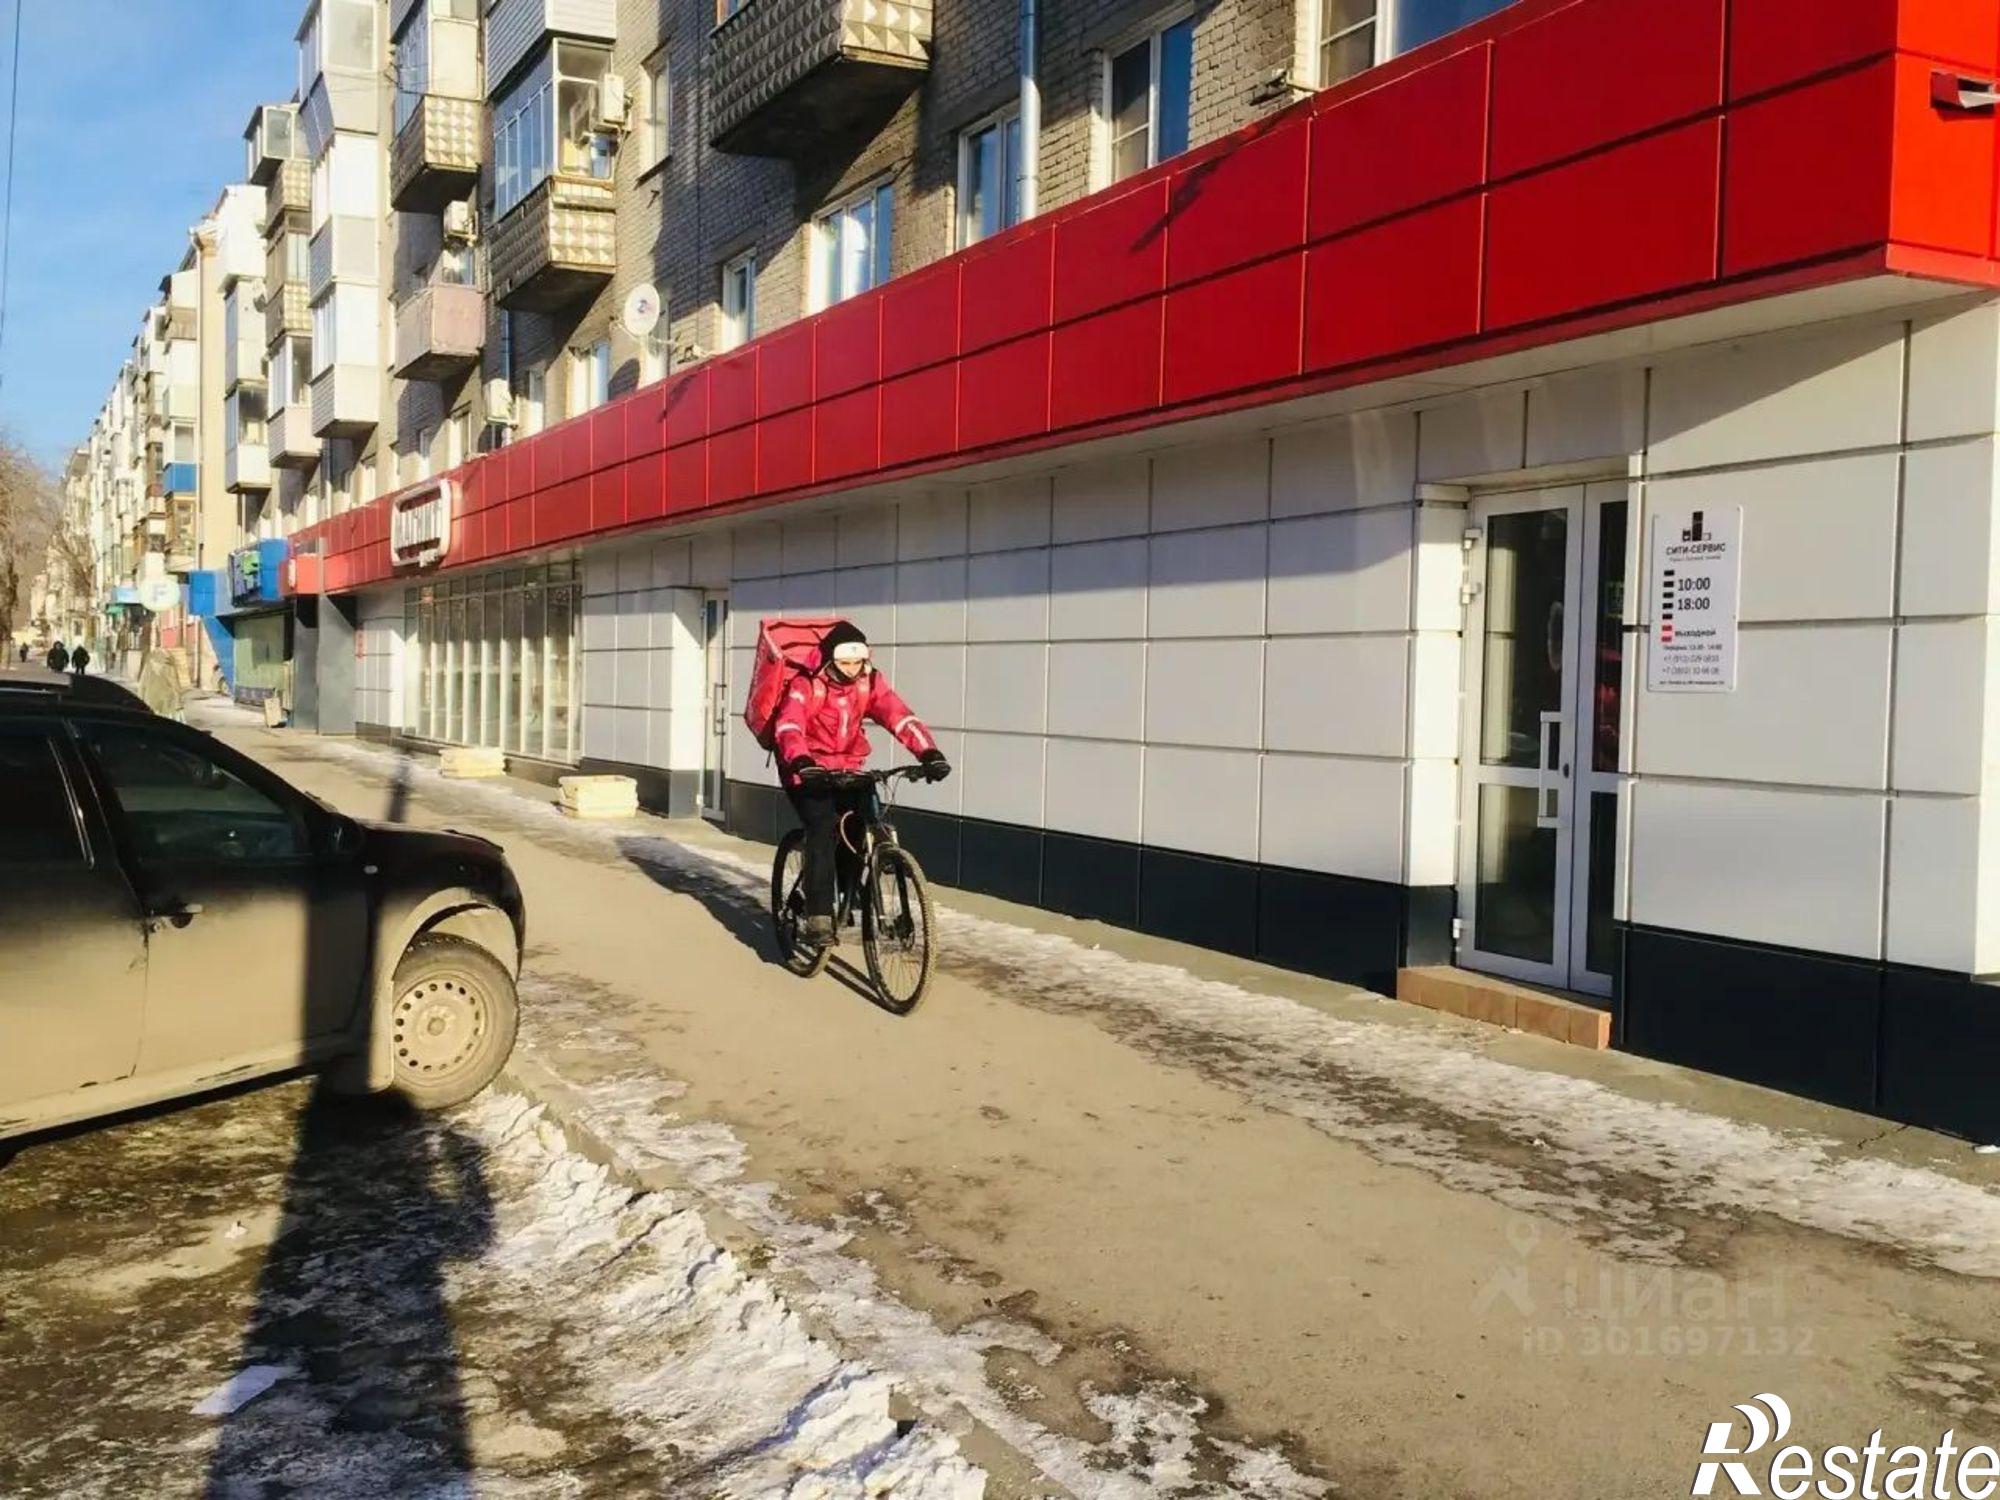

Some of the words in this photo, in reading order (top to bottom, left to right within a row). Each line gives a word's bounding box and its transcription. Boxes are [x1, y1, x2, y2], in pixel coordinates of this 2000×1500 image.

[1666, 543, 1725, 555] СИТИ-СЕРВИС
[1677, 577, 1711, 591] 10:00
[1677, 597, 1711, 610] 18:00
